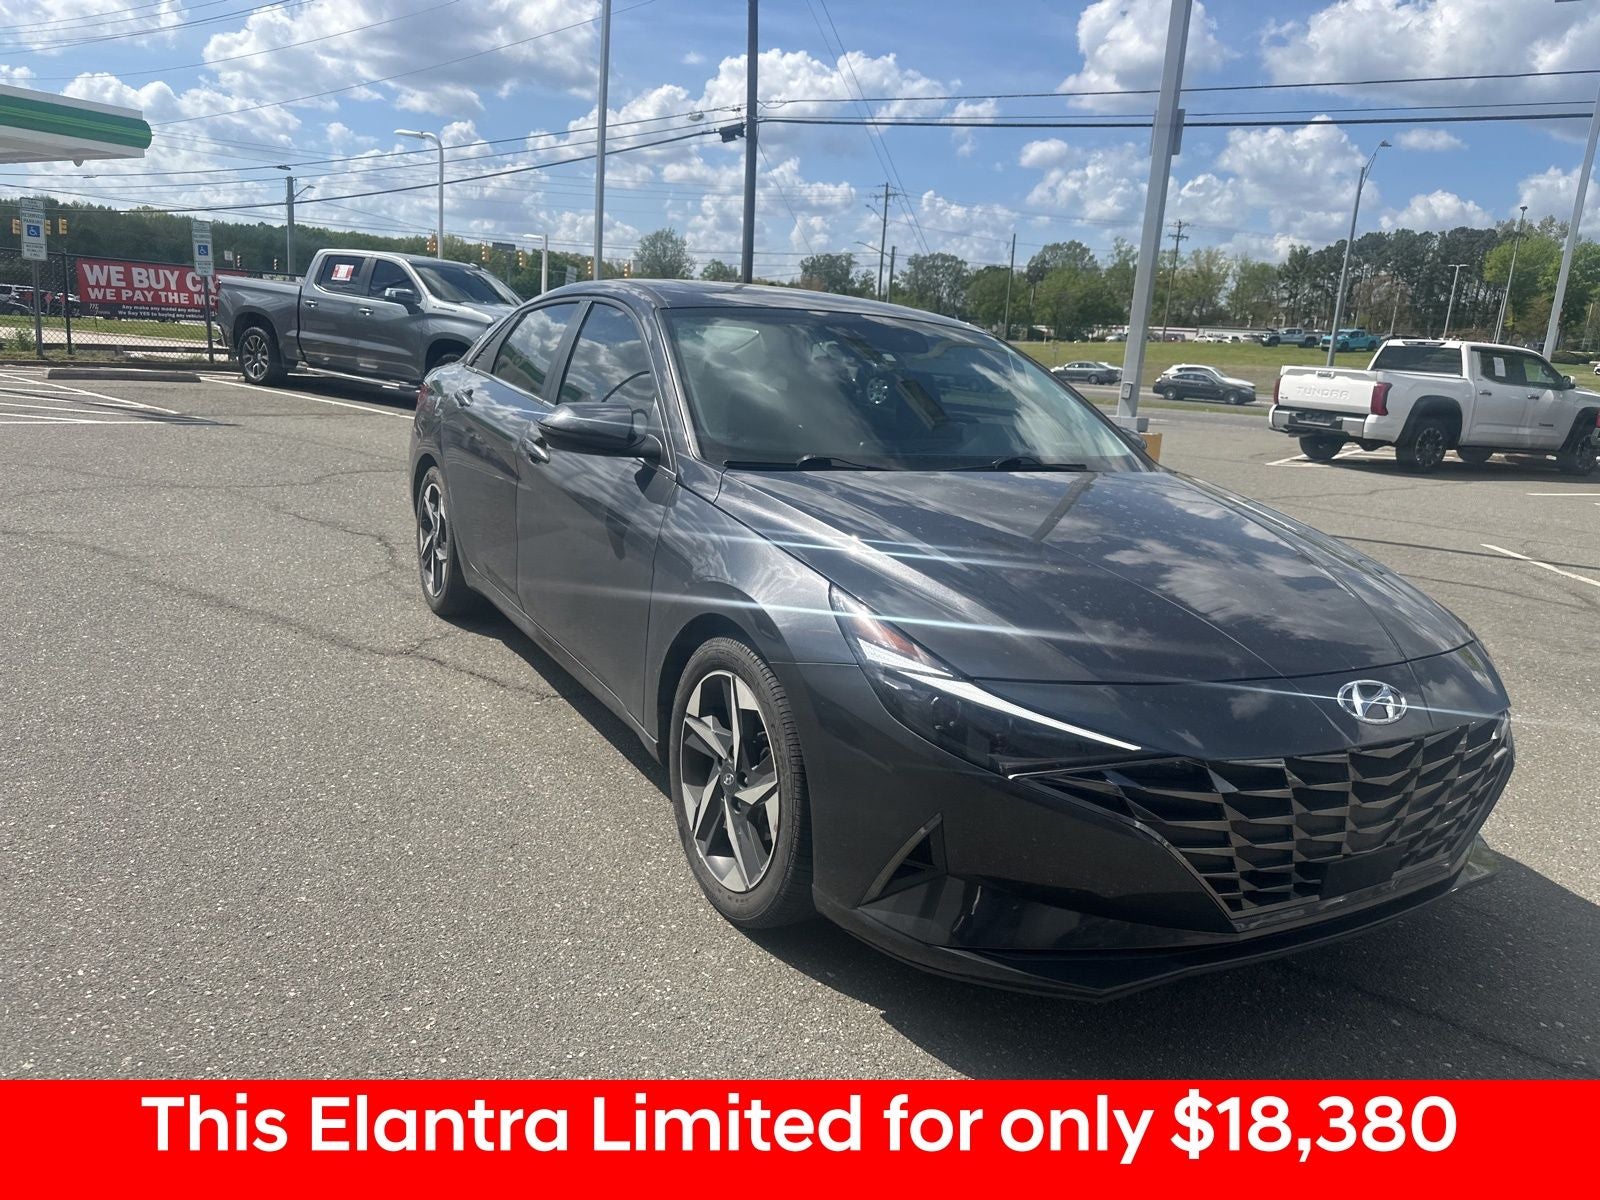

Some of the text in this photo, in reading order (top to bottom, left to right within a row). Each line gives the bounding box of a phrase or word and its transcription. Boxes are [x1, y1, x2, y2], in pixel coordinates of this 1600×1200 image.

[82, 263, 126, 287] WE
[131, 267, 179, 291] BUY
[186, 271, 218, 294] CA
[87, 287, 219, 306] WE PAY THE MO
[1296, 386, 1351, 401] TUNDRA
